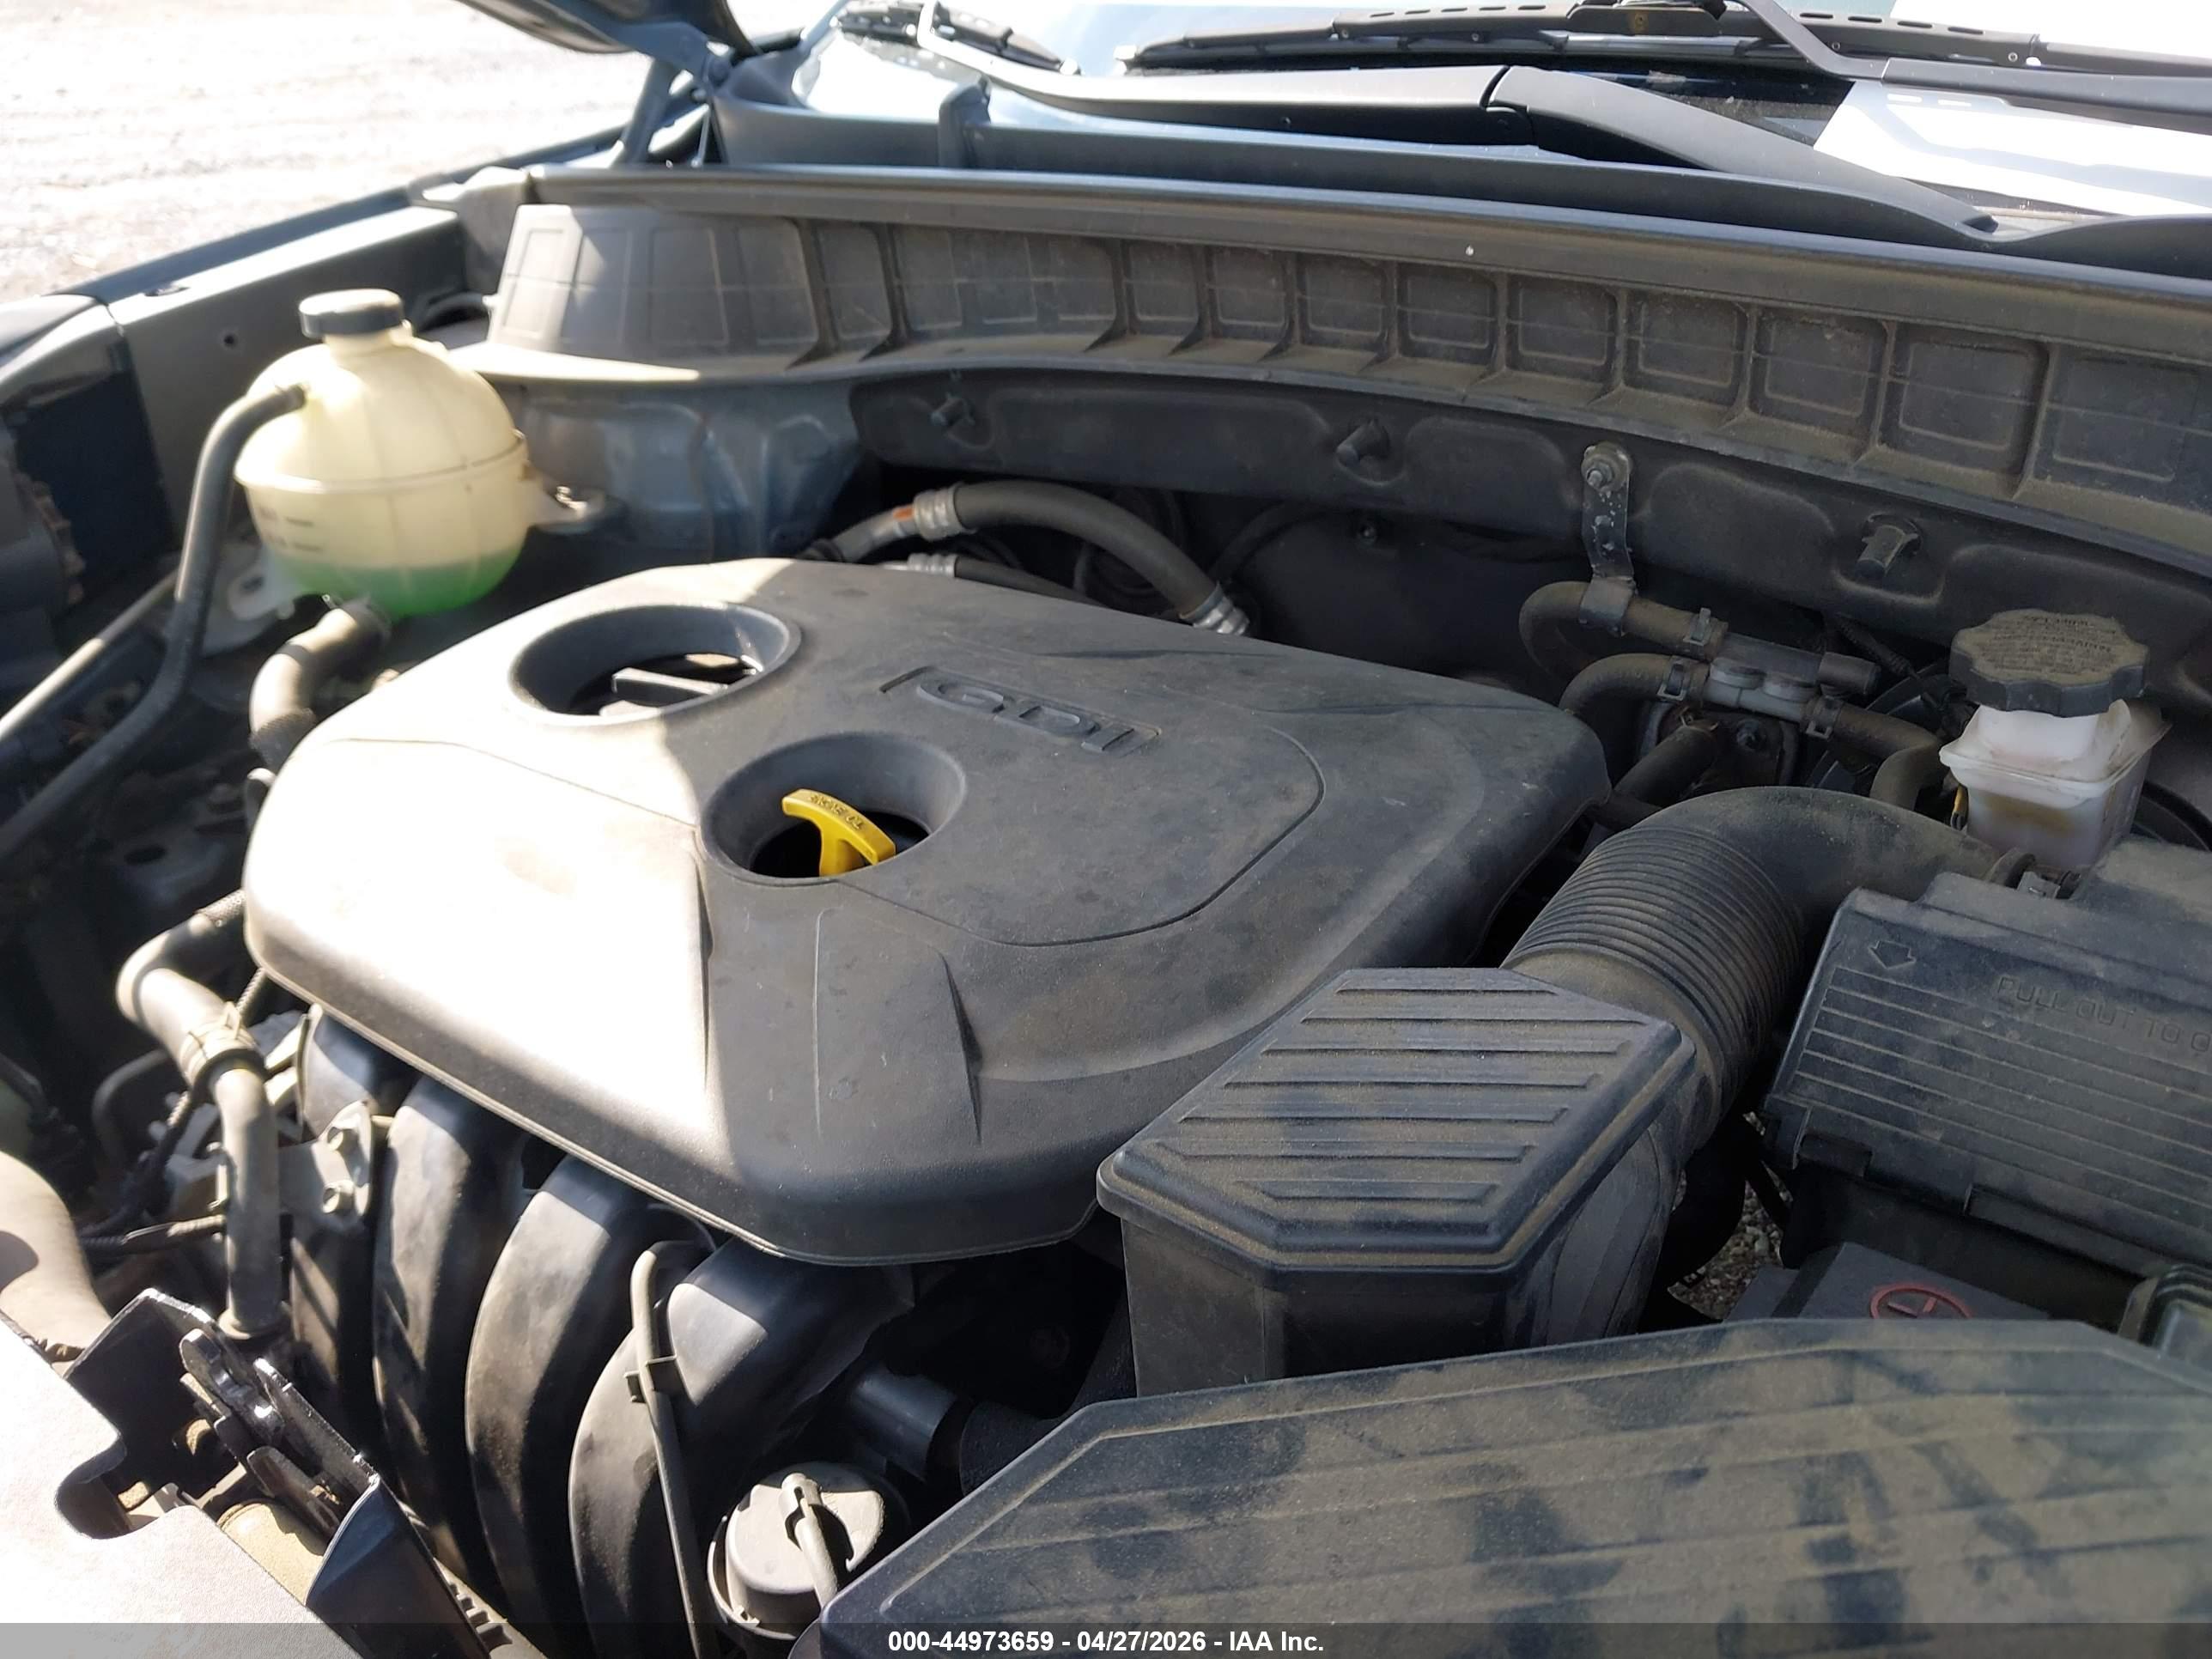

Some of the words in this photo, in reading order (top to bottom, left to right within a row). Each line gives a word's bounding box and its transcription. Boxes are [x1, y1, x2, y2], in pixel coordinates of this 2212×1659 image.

[1997, 975, 2067, 1013] PULL
[2075, 999, 2137, 1030] OUT
[2144, 1017, 2181, 1045] TO
